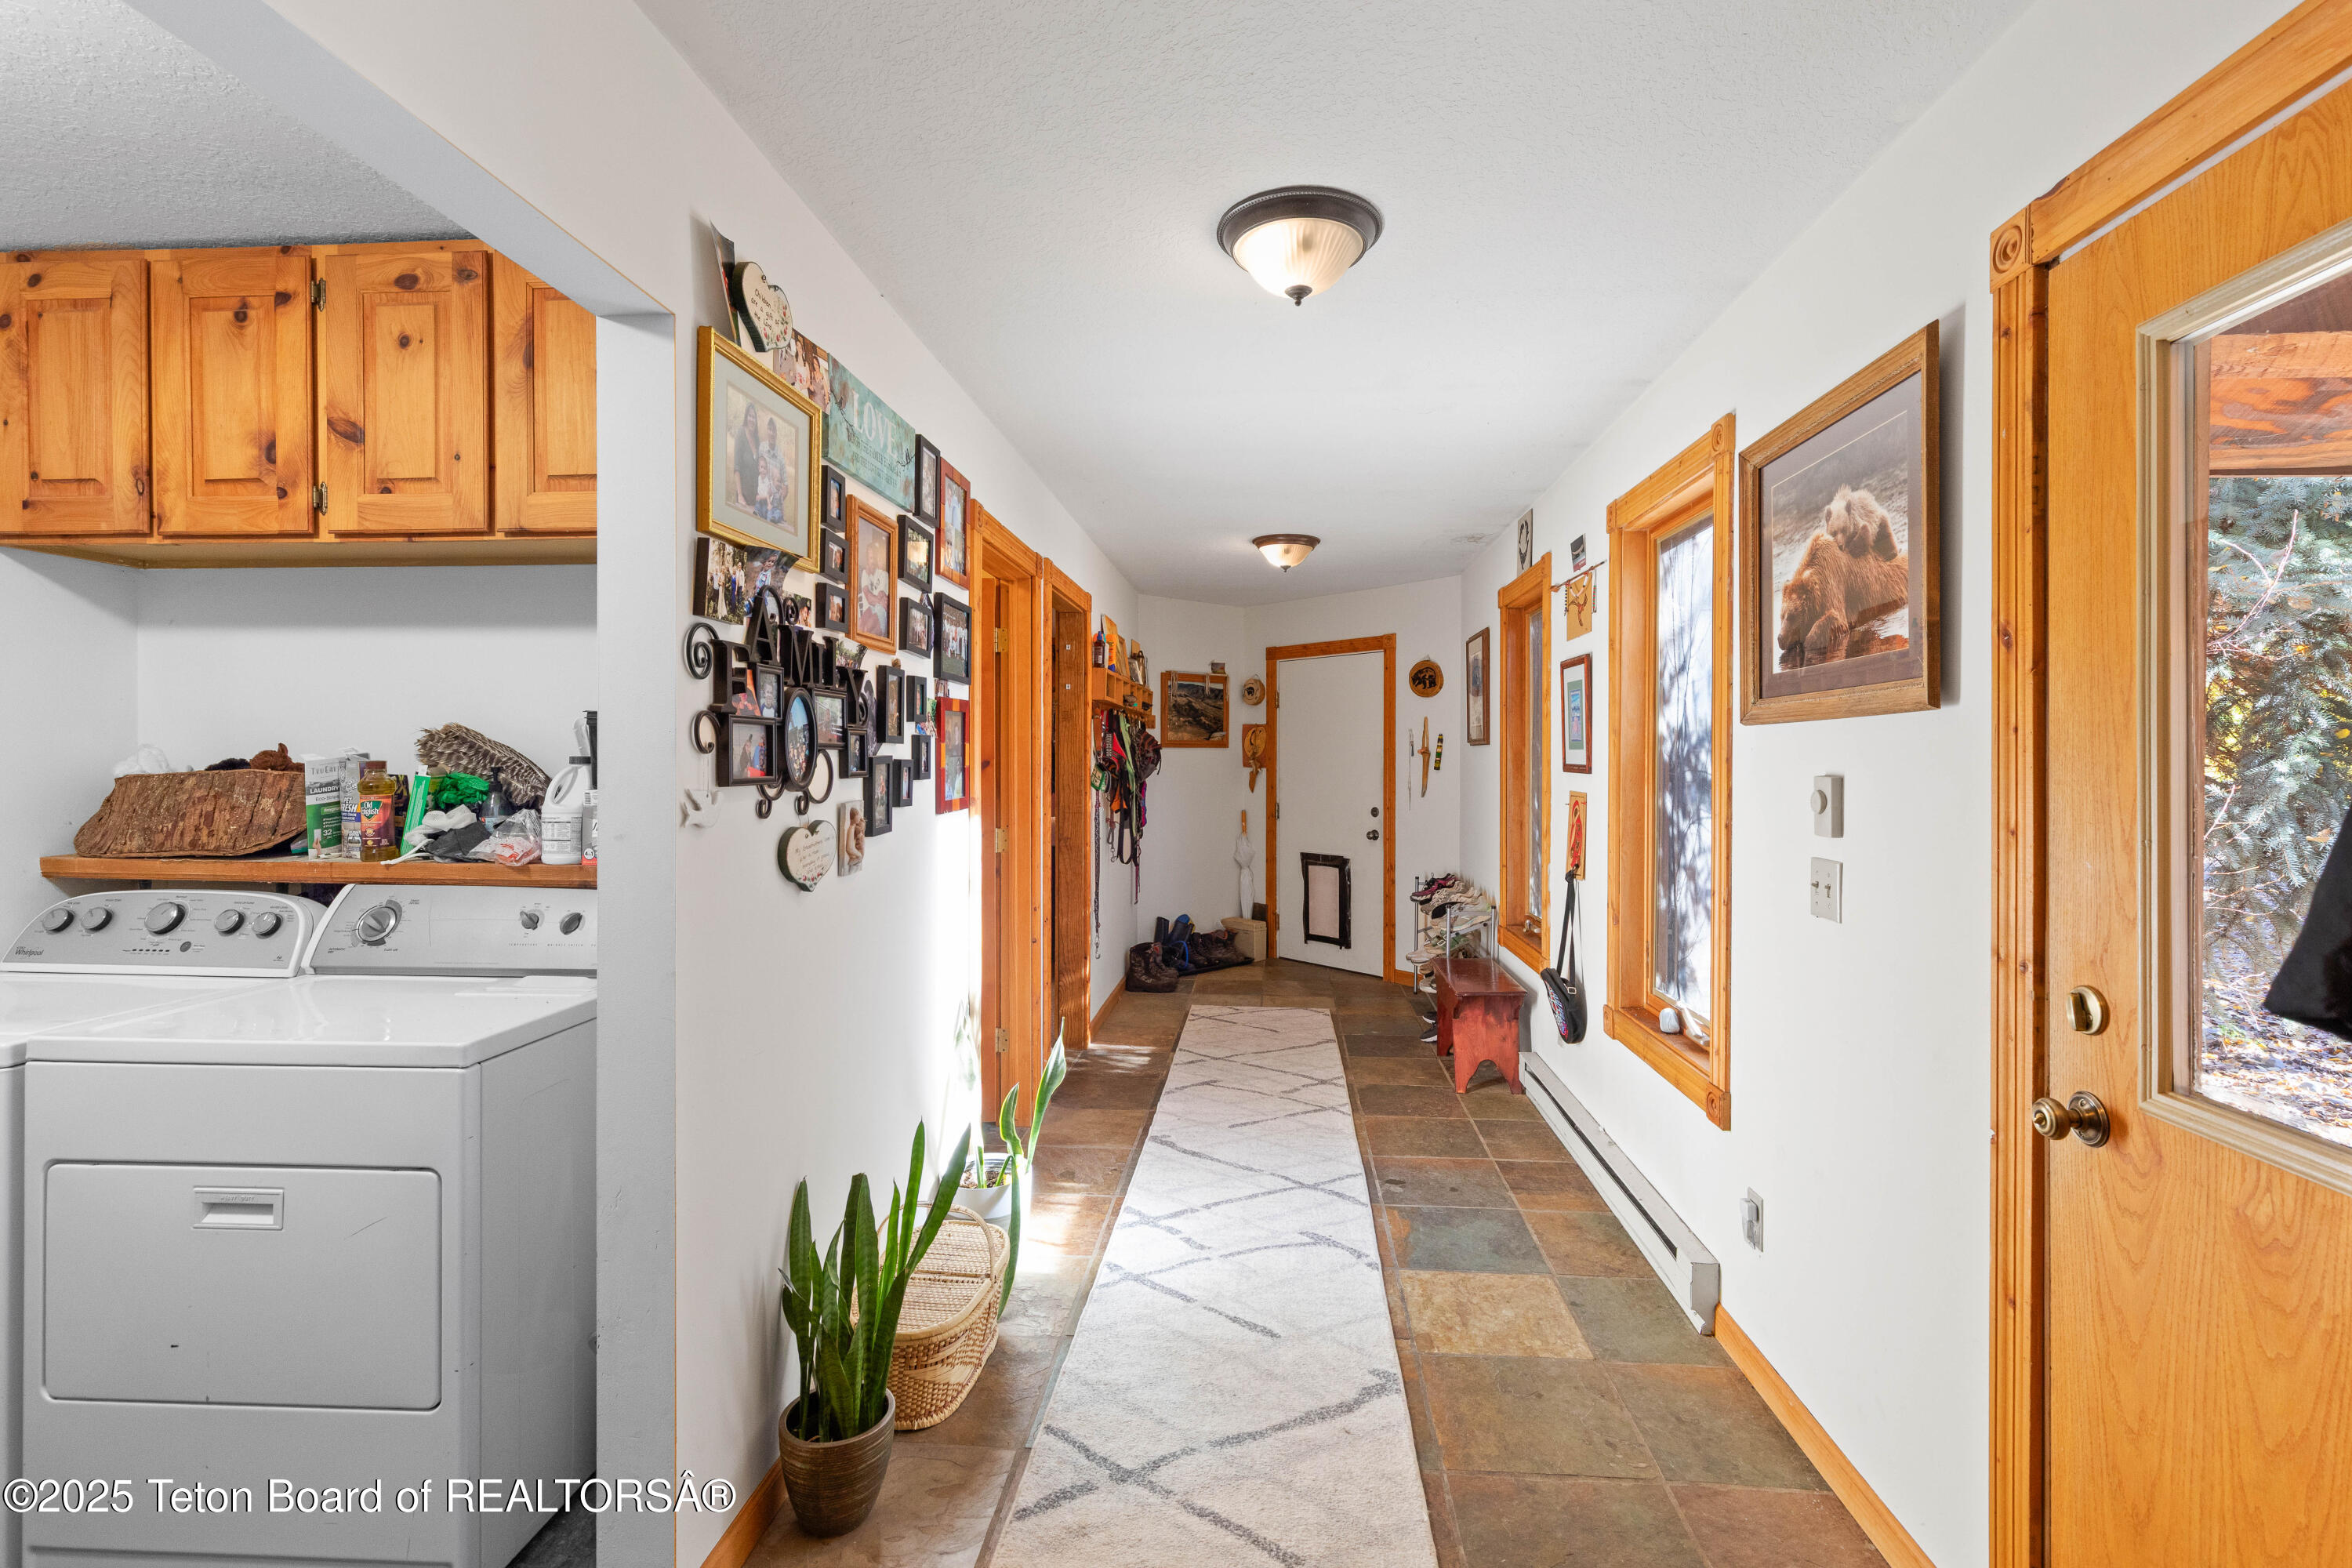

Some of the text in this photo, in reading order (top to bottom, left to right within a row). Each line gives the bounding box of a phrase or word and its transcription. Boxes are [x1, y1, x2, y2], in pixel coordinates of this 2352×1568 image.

[755, 289, 771, 308] Children
[853, 390, 898, 458] LOVE
[711, 594, 869, 728] FAMILY
[310, 785, 339, 794] LAUNDRY
[361, 807, 379, 816] English
